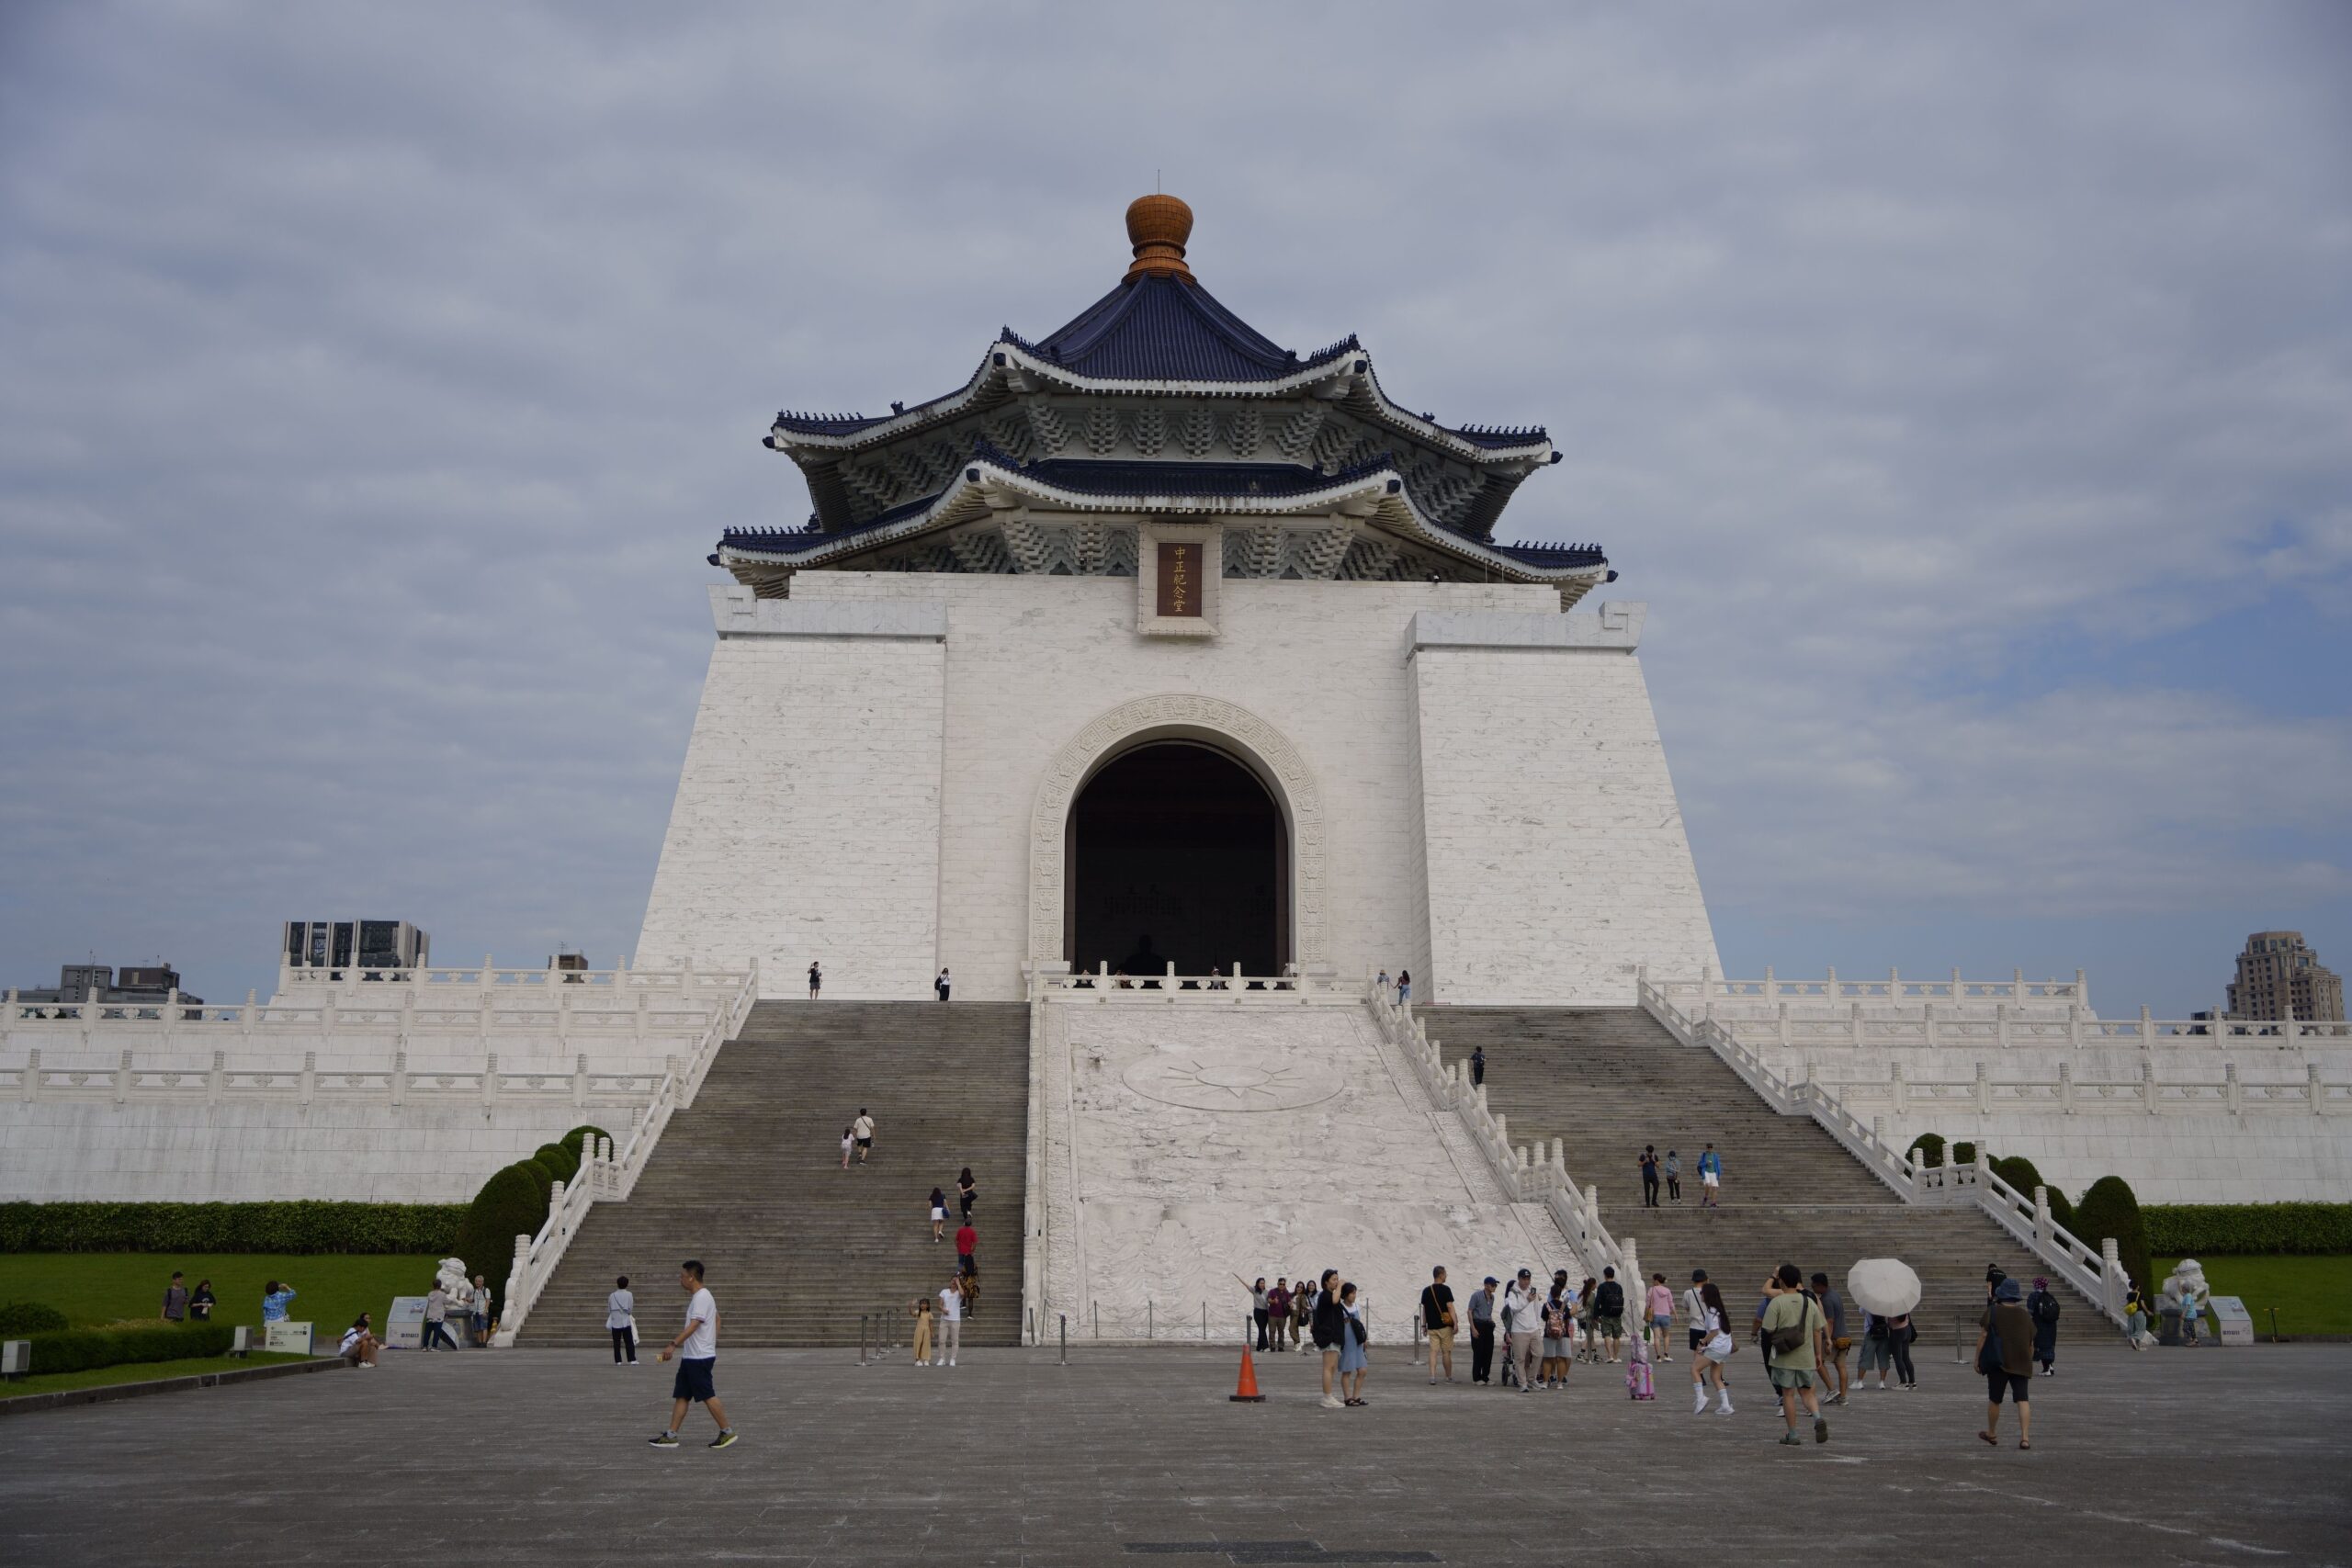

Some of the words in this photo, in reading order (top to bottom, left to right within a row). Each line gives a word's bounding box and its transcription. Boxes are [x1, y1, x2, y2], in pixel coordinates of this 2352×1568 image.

[1173, 546, 1187, 612] 中正紀念堂
